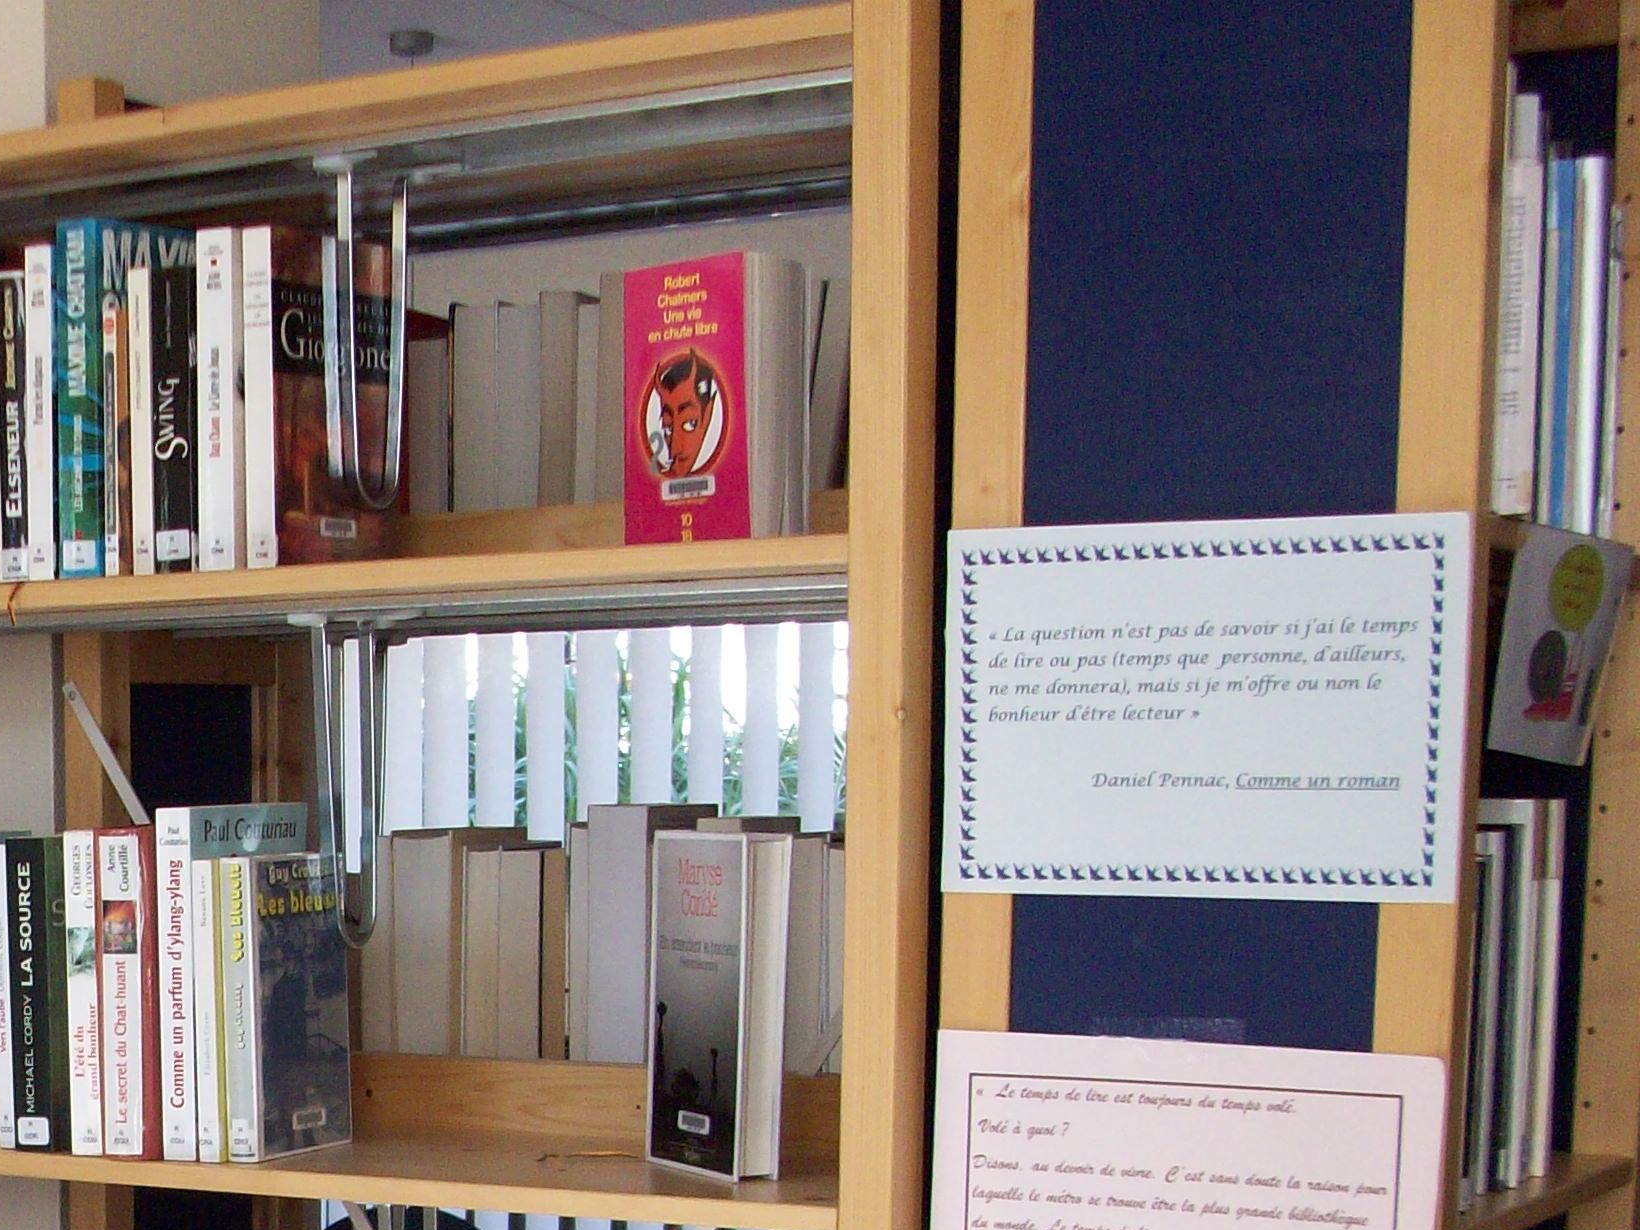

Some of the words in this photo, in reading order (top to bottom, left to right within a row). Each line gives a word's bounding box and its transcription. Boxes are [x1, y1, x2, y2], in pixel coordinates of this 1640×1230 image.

[664, 273, 700, 290] Robert
[658, 290, 707, 308] Chalmers
[663, 311, 684, 324] Une
[687, 308, 702, 321] vie
[648, 330, 662, 343] en
[664, 327, 692, 340] chute
[695, 323, 718, 336] libre
[1001, 626, 1026, 644] La
[1031, 626, 1106, 647] question
[1111, 622, 1153, 640] n'est
[1156, 625, 1189, 645] pas
[1193, 619, 1215, 637] de
[1219, 620, 1279, 636] savoir
[1283, 619, 1299, 636] si
[1301, 617, 1335, 640] j'ai
[1338, 615, 1356, 634] le
[1361, 619, 1419, 638] temps
[988, 650, 1008, 669] de
[1014, 651, 1044, 668] lire
[1049, 656, 1071, 668] ou
[1075, 654, 1107, 674] pas
[1112, 650, 1172, 672] (temps
[1176, 652, 1209, 670] que
[1219, 651, 1307, 670] personne,
[1314, 643, 1406, 664] d'ailleurs,
[988, 684, 1010, 696] ne
[1015, 683, 1041, 696] me
[1045, 677, 1132, 697] donnera),
[1137, 677, 1180, 694] mais
[1184, 677, 1199, 693] si
[1203, 677, 1221, 698] je
[1225, 674, 1291, 697] m'offre
[1296, 679, 1318, 692] ou
[1325, 679, 1361, 691] non
[1366, 672, 1383, 691] le
[987, 704, 1061, 722] bonheur
[1065, 704, 1117, 721] d'être
[1123, 703, 1186, 721] lecteur
[1092, 771, 1154, 789] Daniel
[1157, 772, 1229, 789] Pennac,
[1234, 772, 1301, 790] Comme
[1305, 776, 1332, 790] un
[1336, 776, 1400, 790] roman
[678, 857, 723, 887] Maryse
[16, 862, 33, 952] SOURCE
[166, 860, 185, 961] d'ylang-ylang
[680, 888, 719, 919] Condé
[19, 957, 34, 987] LA
[113, 961, 127, 1036] Chat-huant
[169, 966, 186, 1021] parfum
[22, 995, 34, 1045] CORDY
[114, 1040, 127, 1054] du
[171, 1026, 184, 1045] un
[23, 1049, 36, 1113] MICHAEL
[115, 1057, 128, 1104] secret
[169, 1050, 185, 1109] Comme
[993, 1081, 1016, 1098] Le
[1019, 1086, 1059, 1103] temps
[1063, 1086, 1081, 1101] de
[1084, 1087, 1109, 1103] lire
[1112, 1092, 1135, 1104] est
[1137, 1092, 1193, 1109] toujours
[1196, 1094, 1217, 1108] du
[1220, 1097, 1261, 1114] temps
[115, 1108, 128, 1124] Le
[976, 1117, 1009, 1134] Volé
[1011, 1119, 1022, 1135] à
[1025, 1124, 1057, 1140] quoi
[1030, 1162, 1050, 1172] au
[1053, 1160, 1095, 1175] devoir
[1098, 1163, 1116, 1177] de
[1207, 1173, 1240, 1185] sans
[1243, 1173, 1282, 1188] doute
[1285, 1175, 1301, 1190] la
[1306, 1180, 1350, 1193] raison
[1352, 1182, 1388, 1197] pour
[971, 1184, 1025, 1206] laquelle
[1027, 1187, 1041, 1202] le
[1044, 1188, 1082, 1204] métro
[1086, 1195, 1102, 1206] se
[1105, 1195, 1147, 1209] trouve
[1150, 1195, 1177, 1211] être
[1180, 1198, 1196, 1213] la
[1198, 1200, 1230, 1216] plus
[1234, 1205, 1283, 1220] grande
[1287, 1205, 1368, 1229] bibliothèque
[971, 1216, 990, 1230] du
